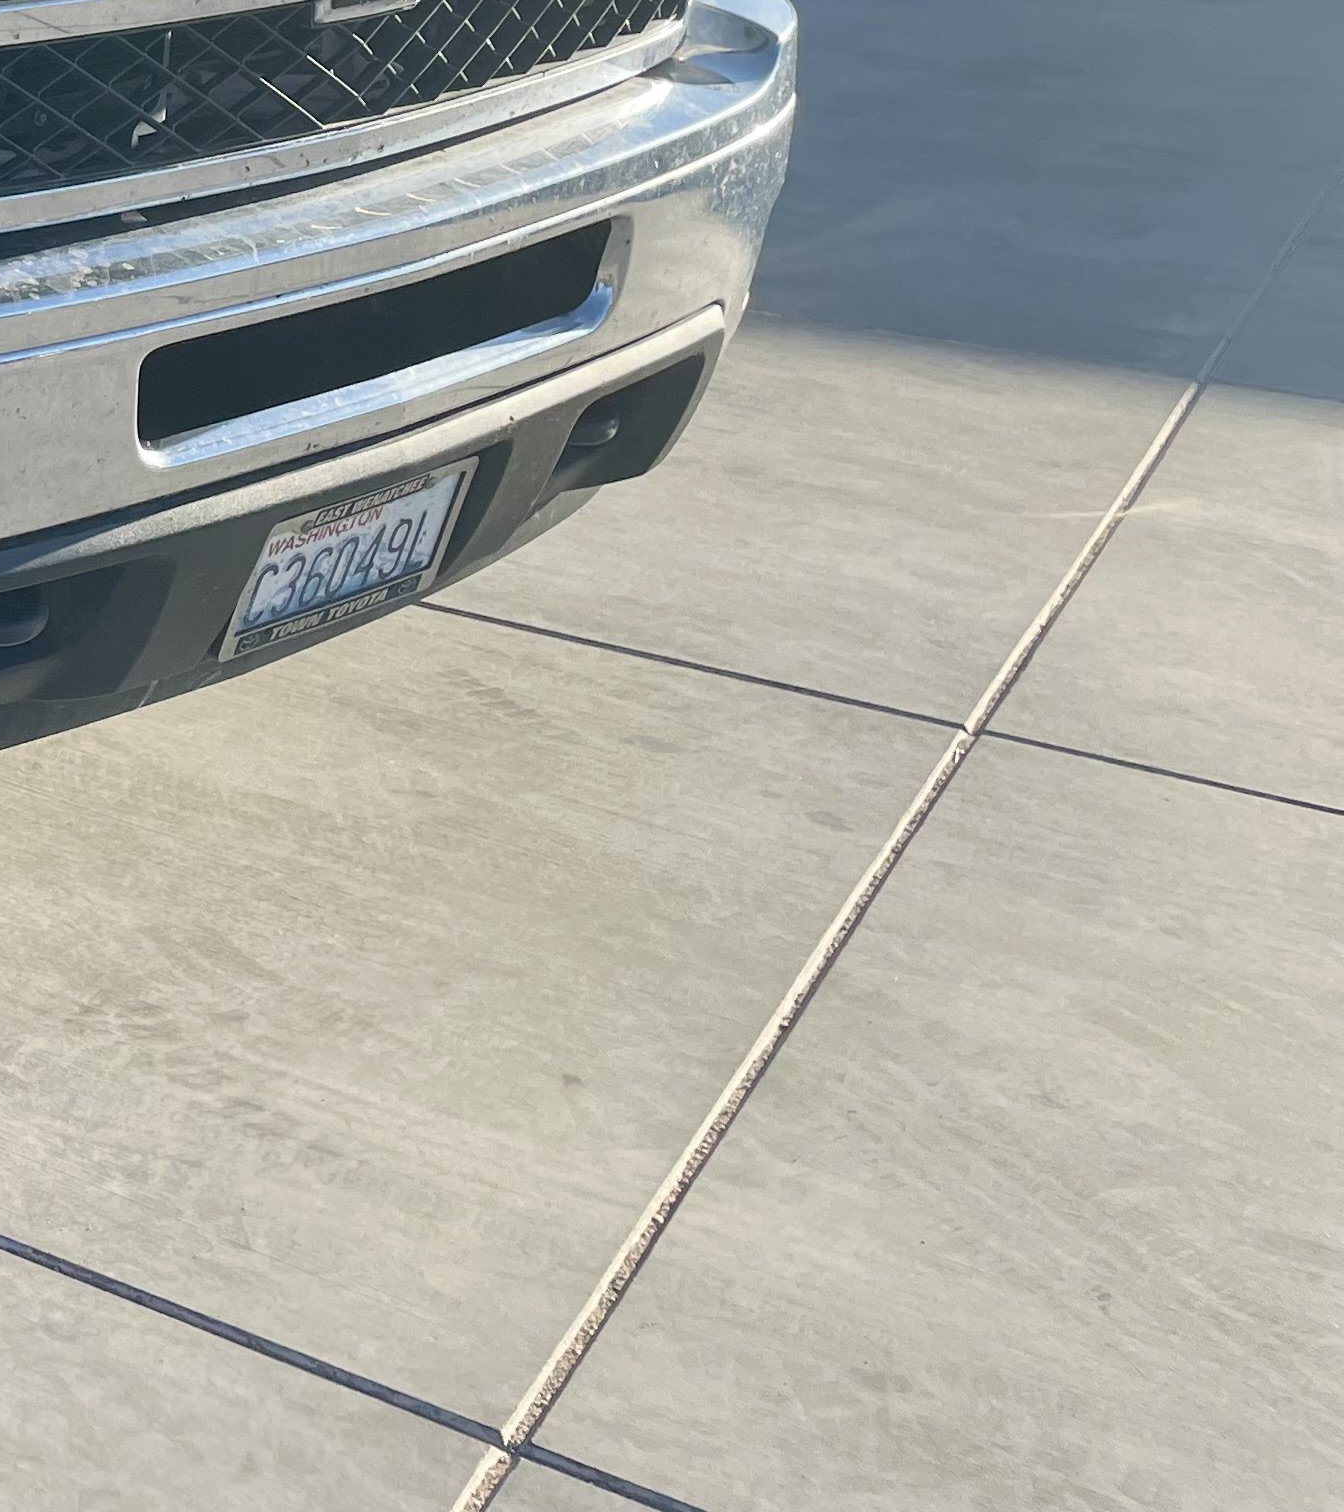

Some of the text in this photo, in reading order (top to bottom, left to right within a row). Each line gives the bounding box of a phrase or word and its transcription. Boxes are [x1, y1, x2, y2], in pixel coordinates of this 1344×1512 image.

[315, 476, 428, 527] EAST WENATCHEE
[267, 505, 384, 558] WASHINGTON
[242, 509, 428, 625] C36049L
[269, 586, 391, 642] TOWN TOYOTA
